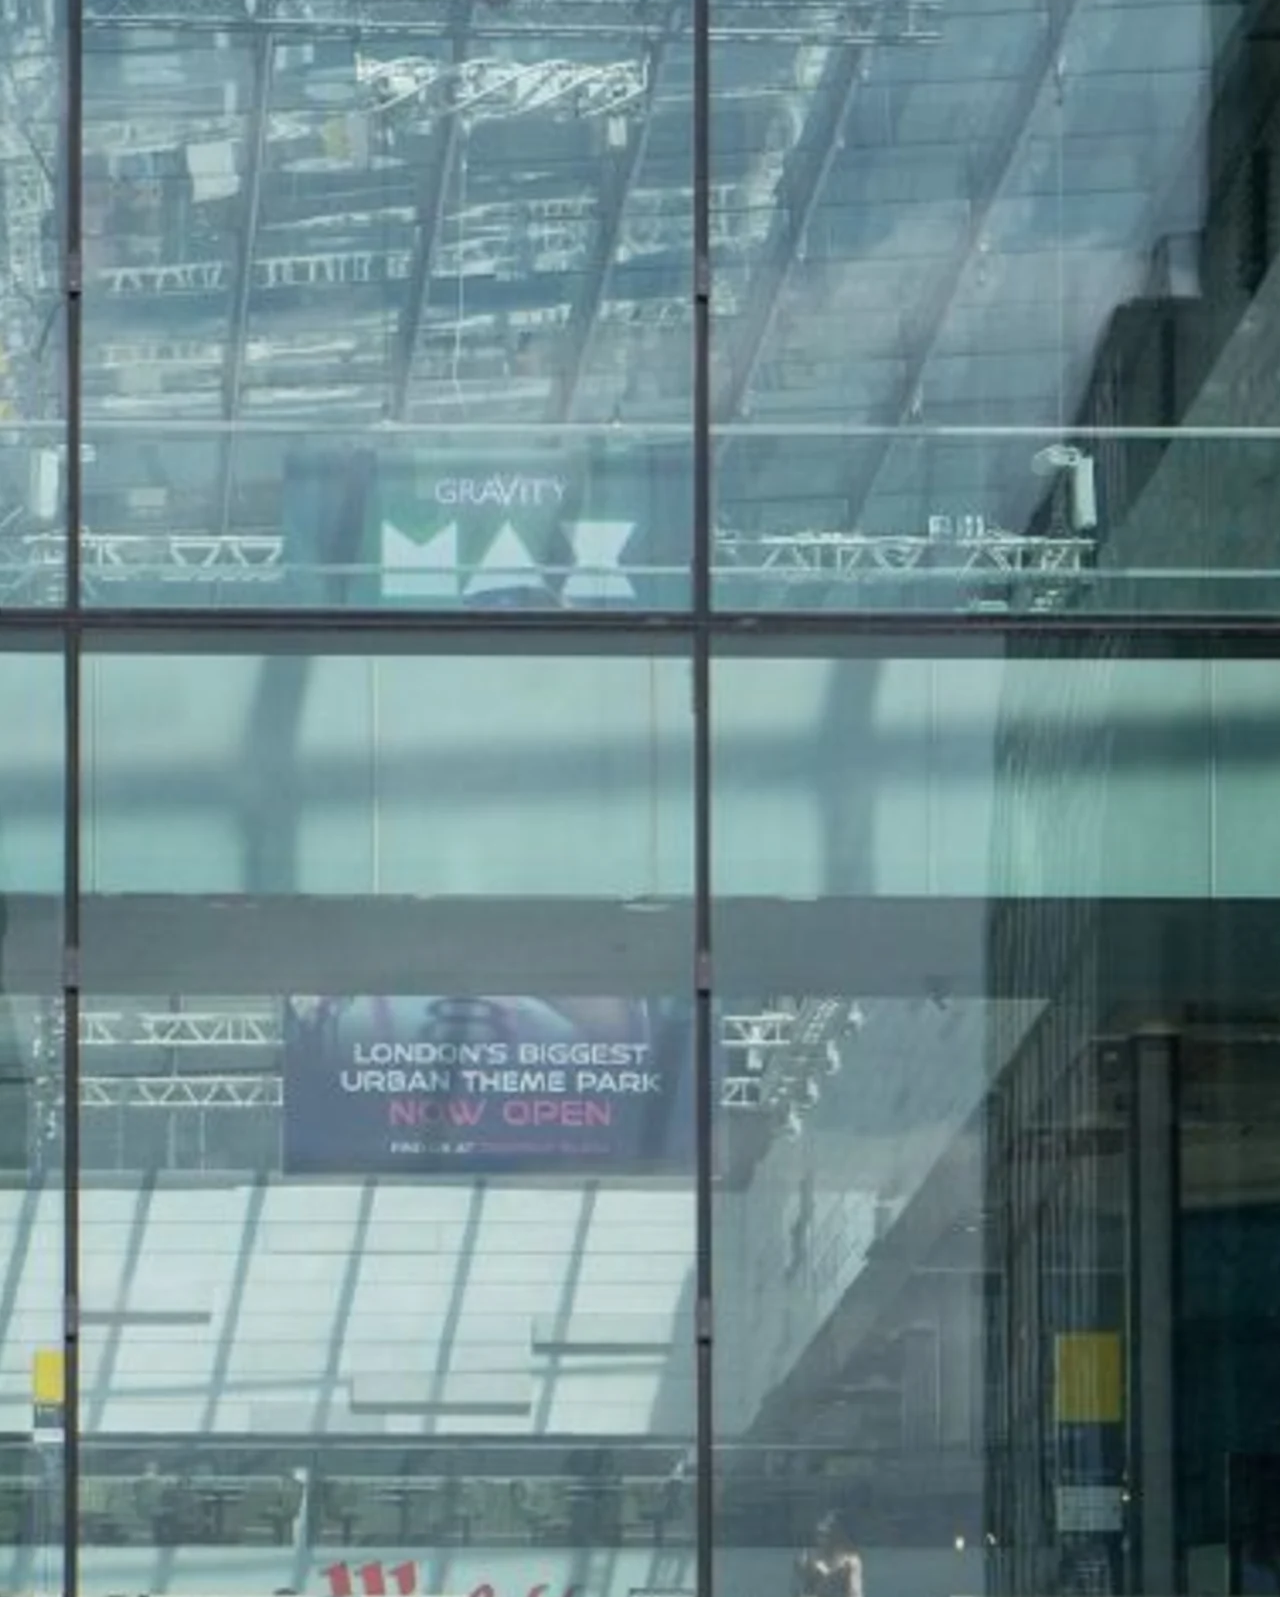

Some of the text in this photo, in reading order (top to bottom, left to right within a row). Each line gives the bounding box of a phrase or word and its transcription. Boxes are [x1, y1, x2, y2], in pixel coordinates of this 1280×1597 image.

[434, 471, 567, 506] GRAVITY
[380, 519, 638, 600] MAX
[353, 1042, 650, 1065] LONDON'S BIGGEST
[340, 1070, 662, 1093] URBAN THEME PARK
[389, 1099, 612, 1127] NOW OPEN
